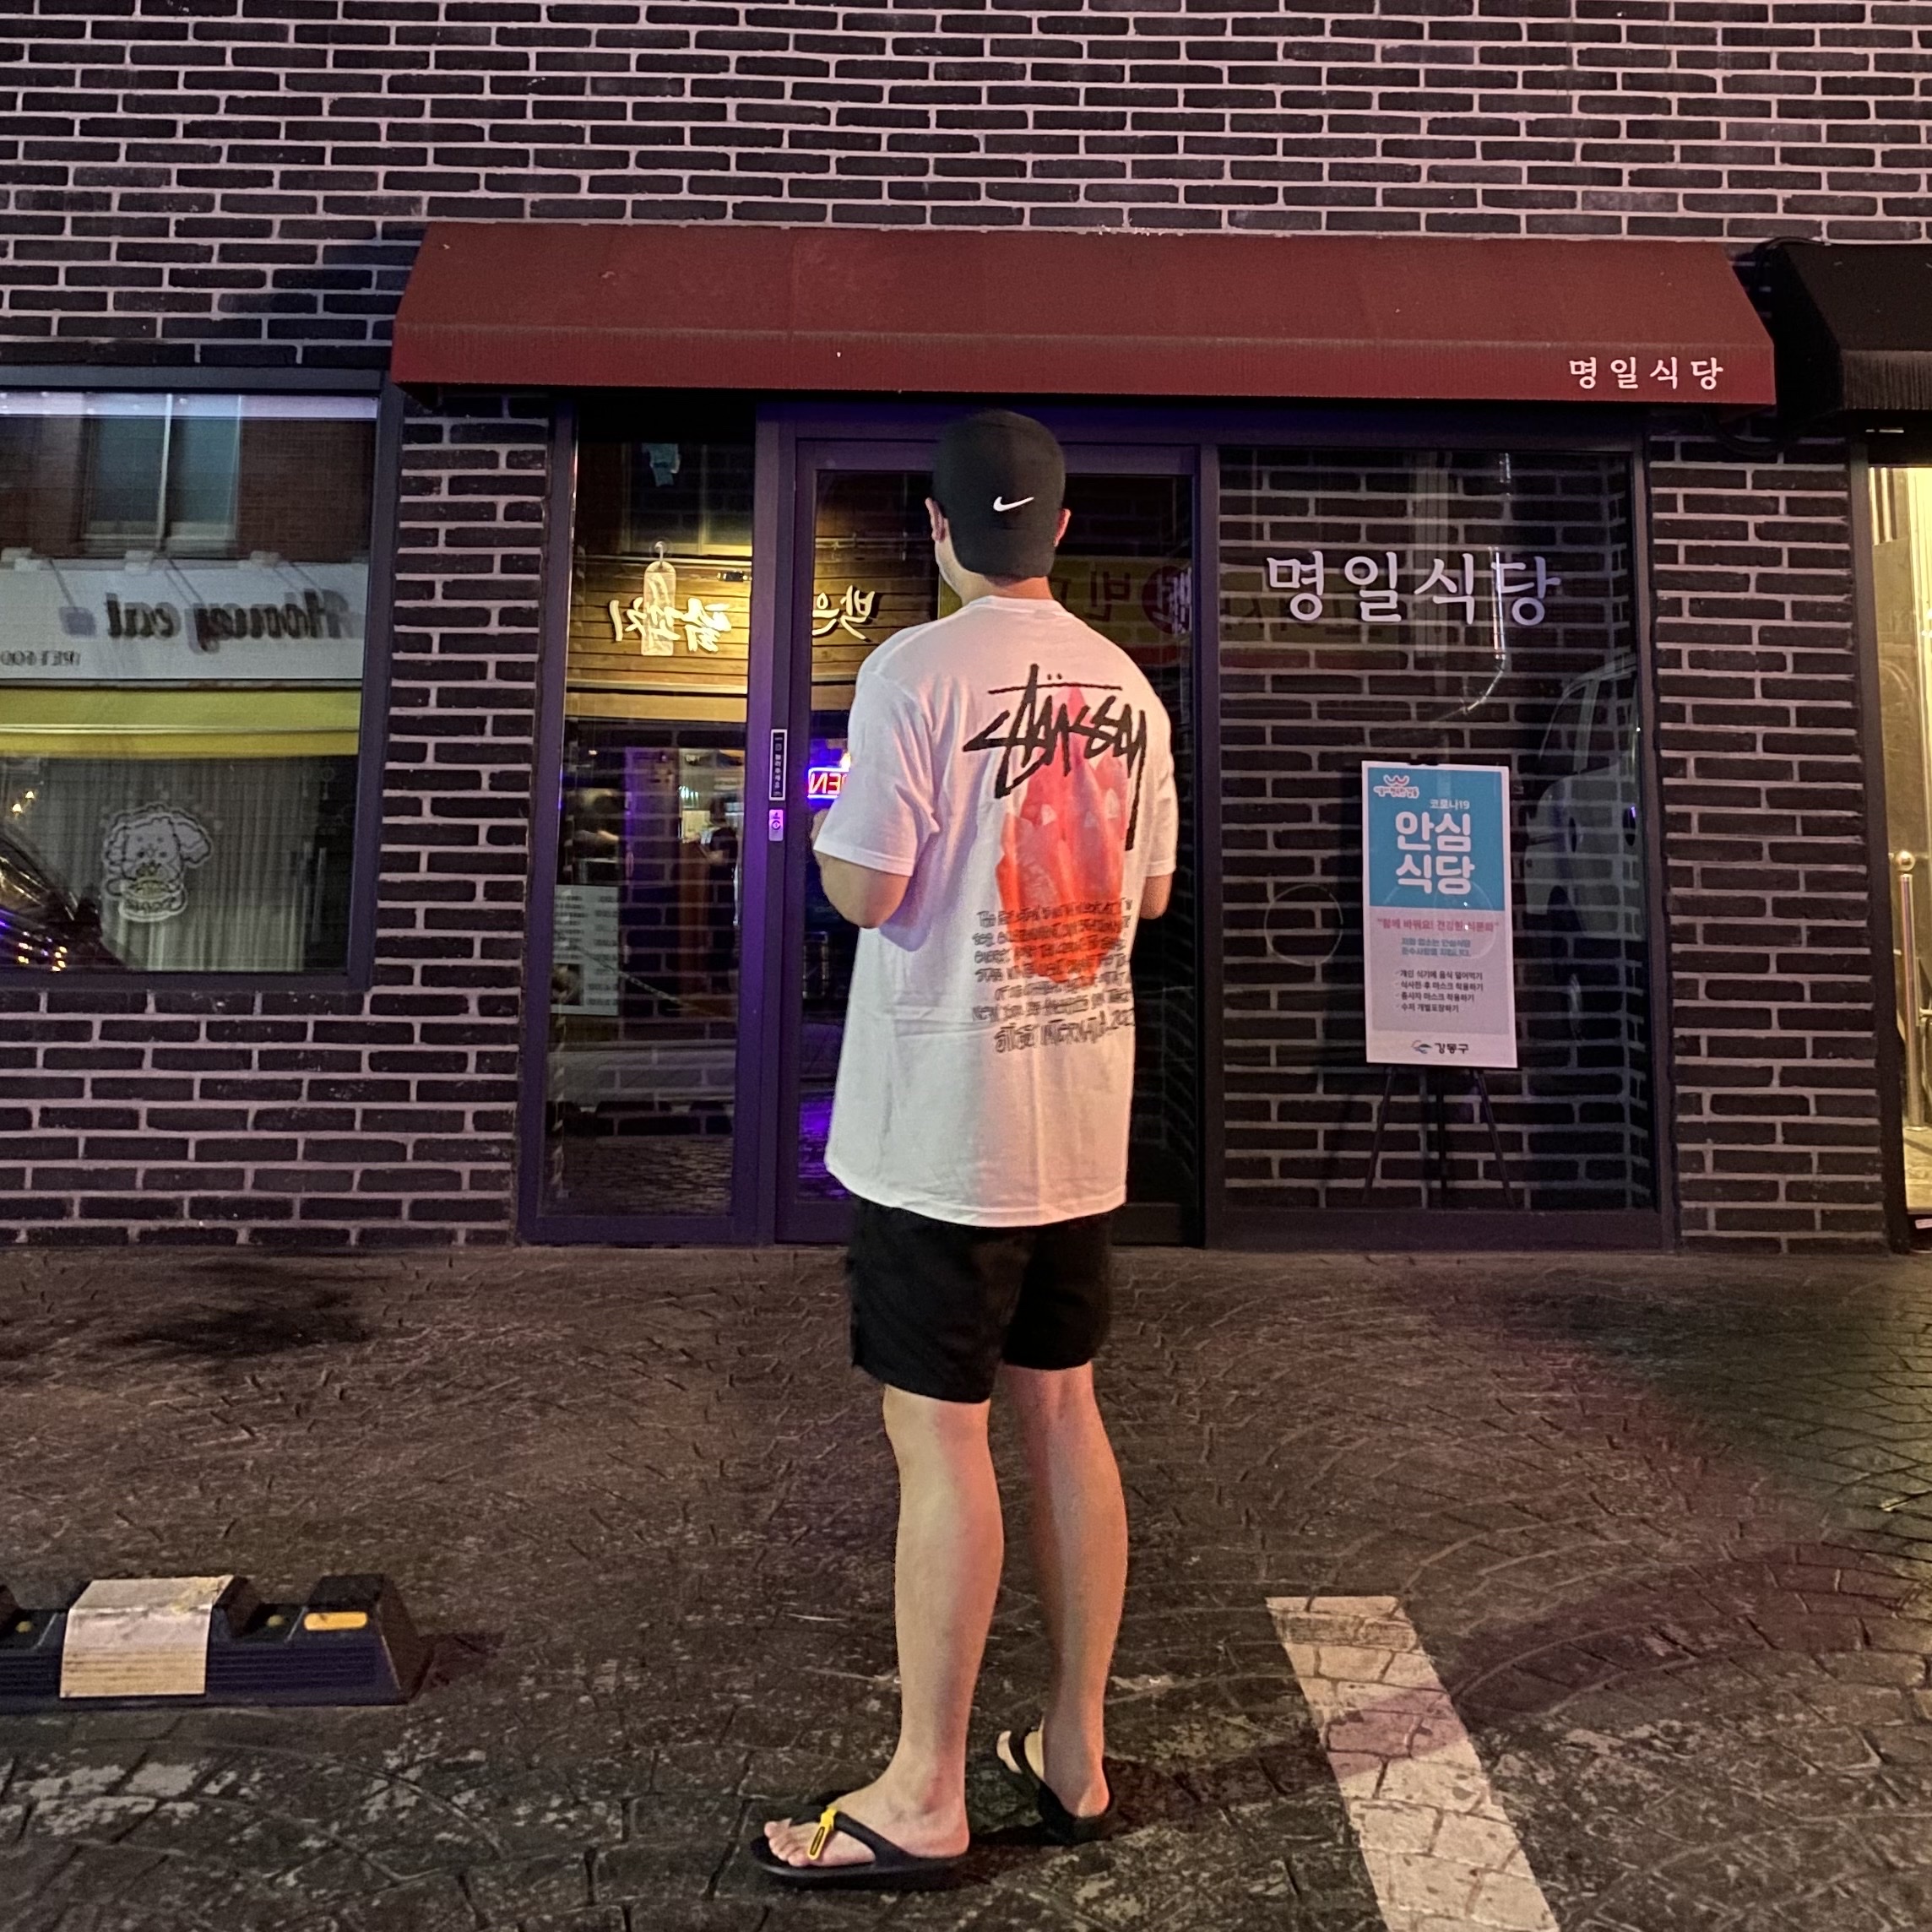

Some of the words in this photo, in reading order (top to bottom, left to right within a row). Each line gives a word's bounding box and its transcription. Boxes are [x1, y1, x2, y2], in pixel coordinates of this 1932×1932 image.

[1569, 356, 1724, 390] 명일식당
[1267, 551, 1561, 626] 명일식당
[1429, 799, 1470, 811] 코로나19
[1395, 811, 1471, 852] 안심
[1396, 854, 1475, 894] 식당
[1400, 969, 1414, 979] 개인
[1416, 970, 1438, 980] 식기에
[1439, 970, 1453, 980] 음식
[1432, 982, 1454, 990] 마스크
[1455, 983, 1484, 991] 착용하기
[1424, 992, 1446, 1001] 마스크
[1446, 993, 1475, 1002] 착용하기
[1401, 1002, 1415, 1012] 수저
[1435, 1042, 1470, 1055] 강동구
